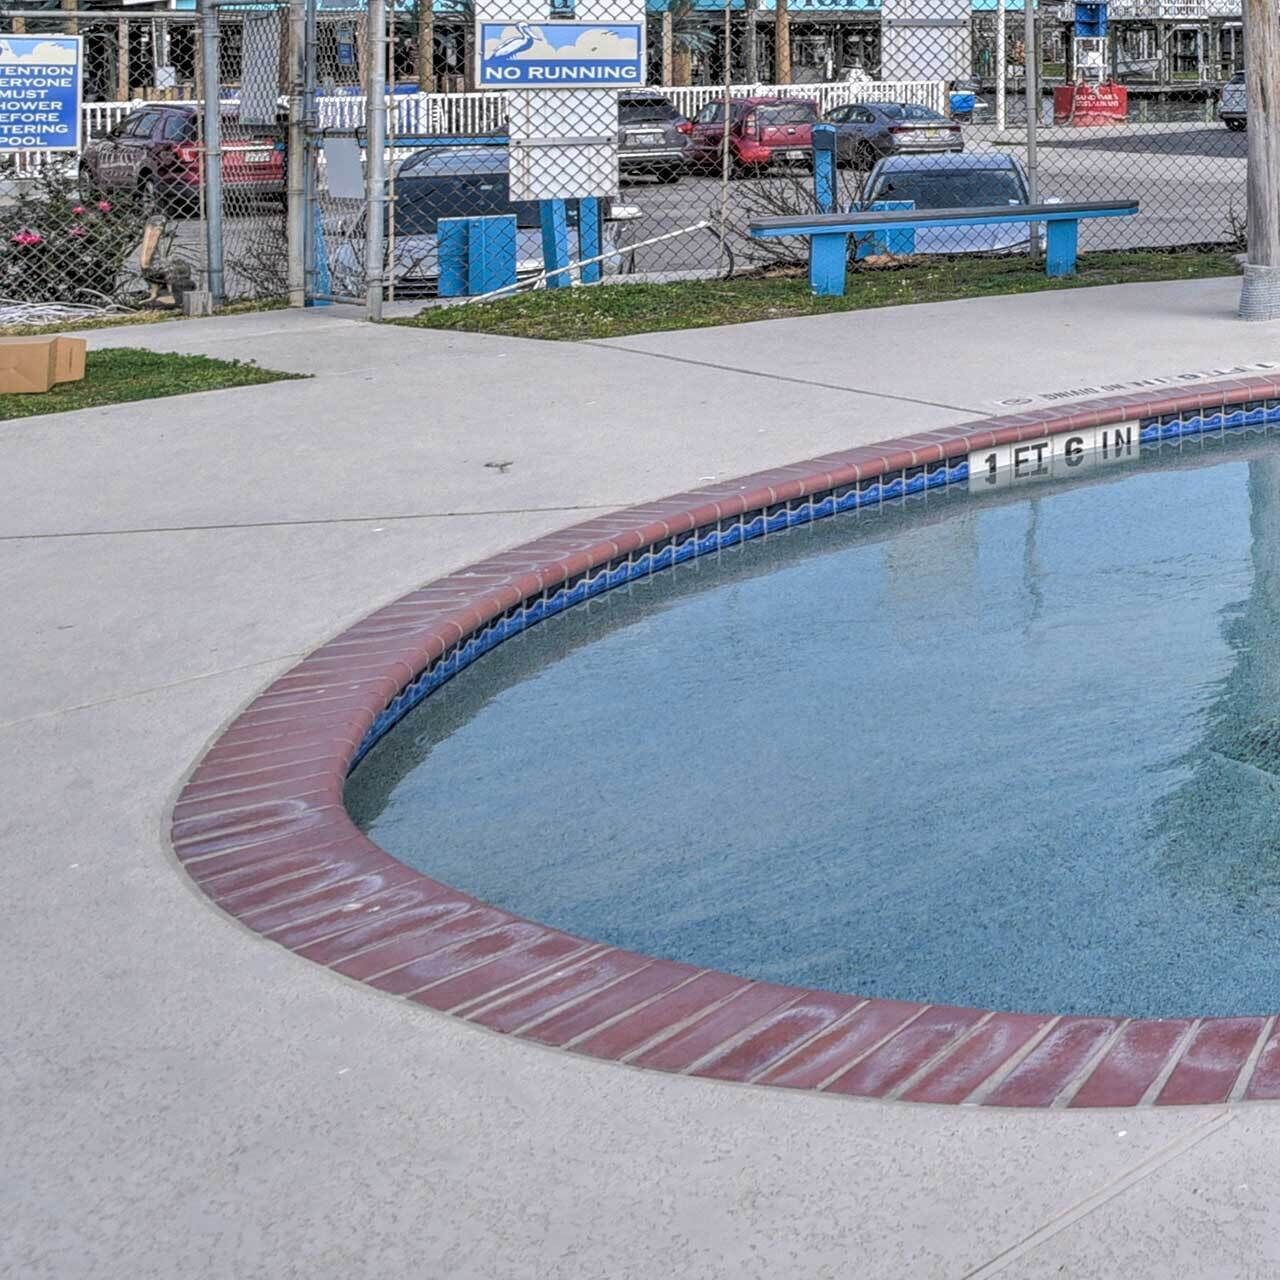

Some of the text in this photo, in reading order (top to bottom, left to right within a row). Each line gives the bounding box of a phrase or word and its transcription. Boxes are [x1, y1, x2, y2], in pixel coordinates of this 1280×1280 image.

[486, 65, 637, 80] NO RUNNING
[0, 89, 48, 99] MUST
[0, 136, 48, 146] POOL
[1102, 427, 1131, 451] IN
